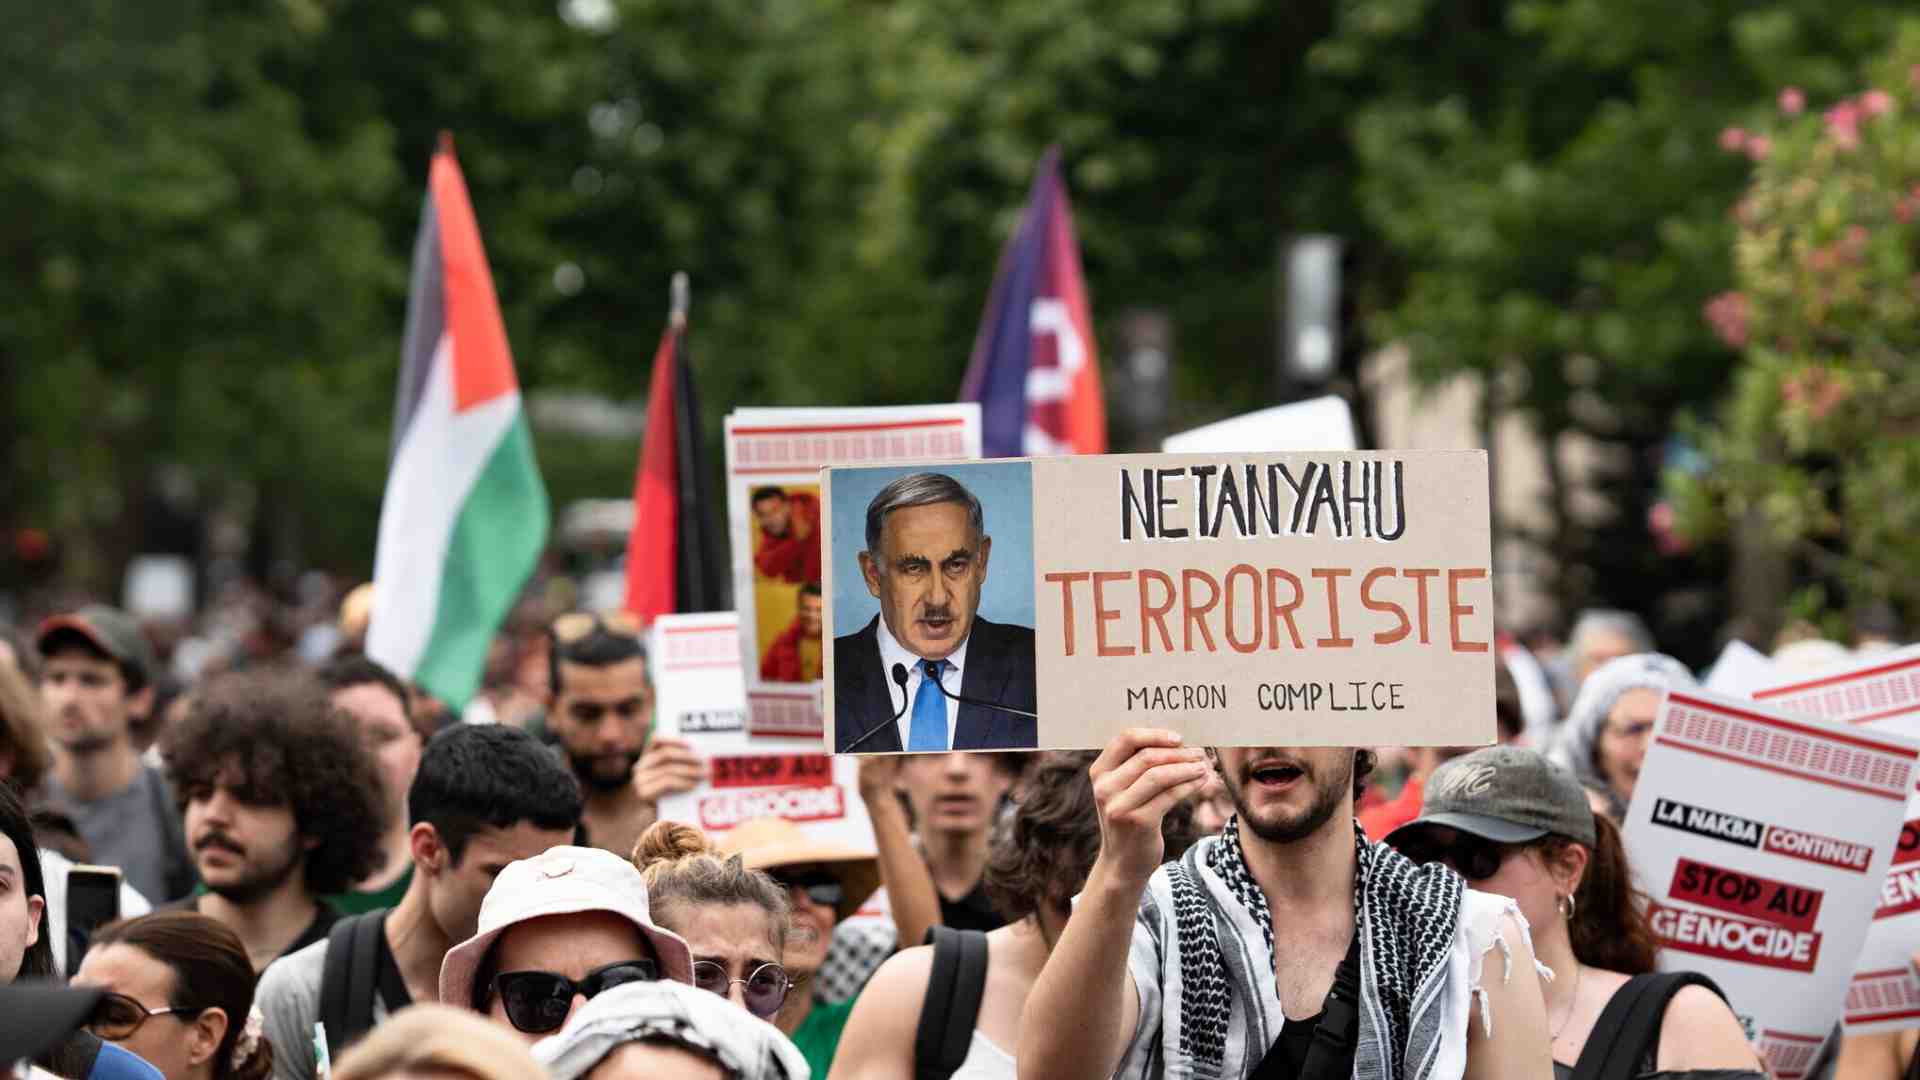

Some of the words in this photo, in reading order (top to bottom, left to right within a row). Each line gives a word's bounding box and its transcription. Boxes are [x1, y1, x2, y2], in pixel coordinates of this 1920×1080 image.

[1120, 459, 1407, 542] NETANYAHU
[1045, 563, 1489, 656] TERRORISTE
[1127, 684, 1227, 711] MACRON
[1258, 681, 1405, 712] COMPLICE
[1656, 800, 1684, 824] LA
[1687, 808, 1758, 843] NAKBA
[1769, 830, 1868, 866] CONTINUE
[1680, 863, 1761, 904] STOP
[1766, 886, 1813, 917] AU
[1652, 906, 1814, 962] GÉNOCIDE
